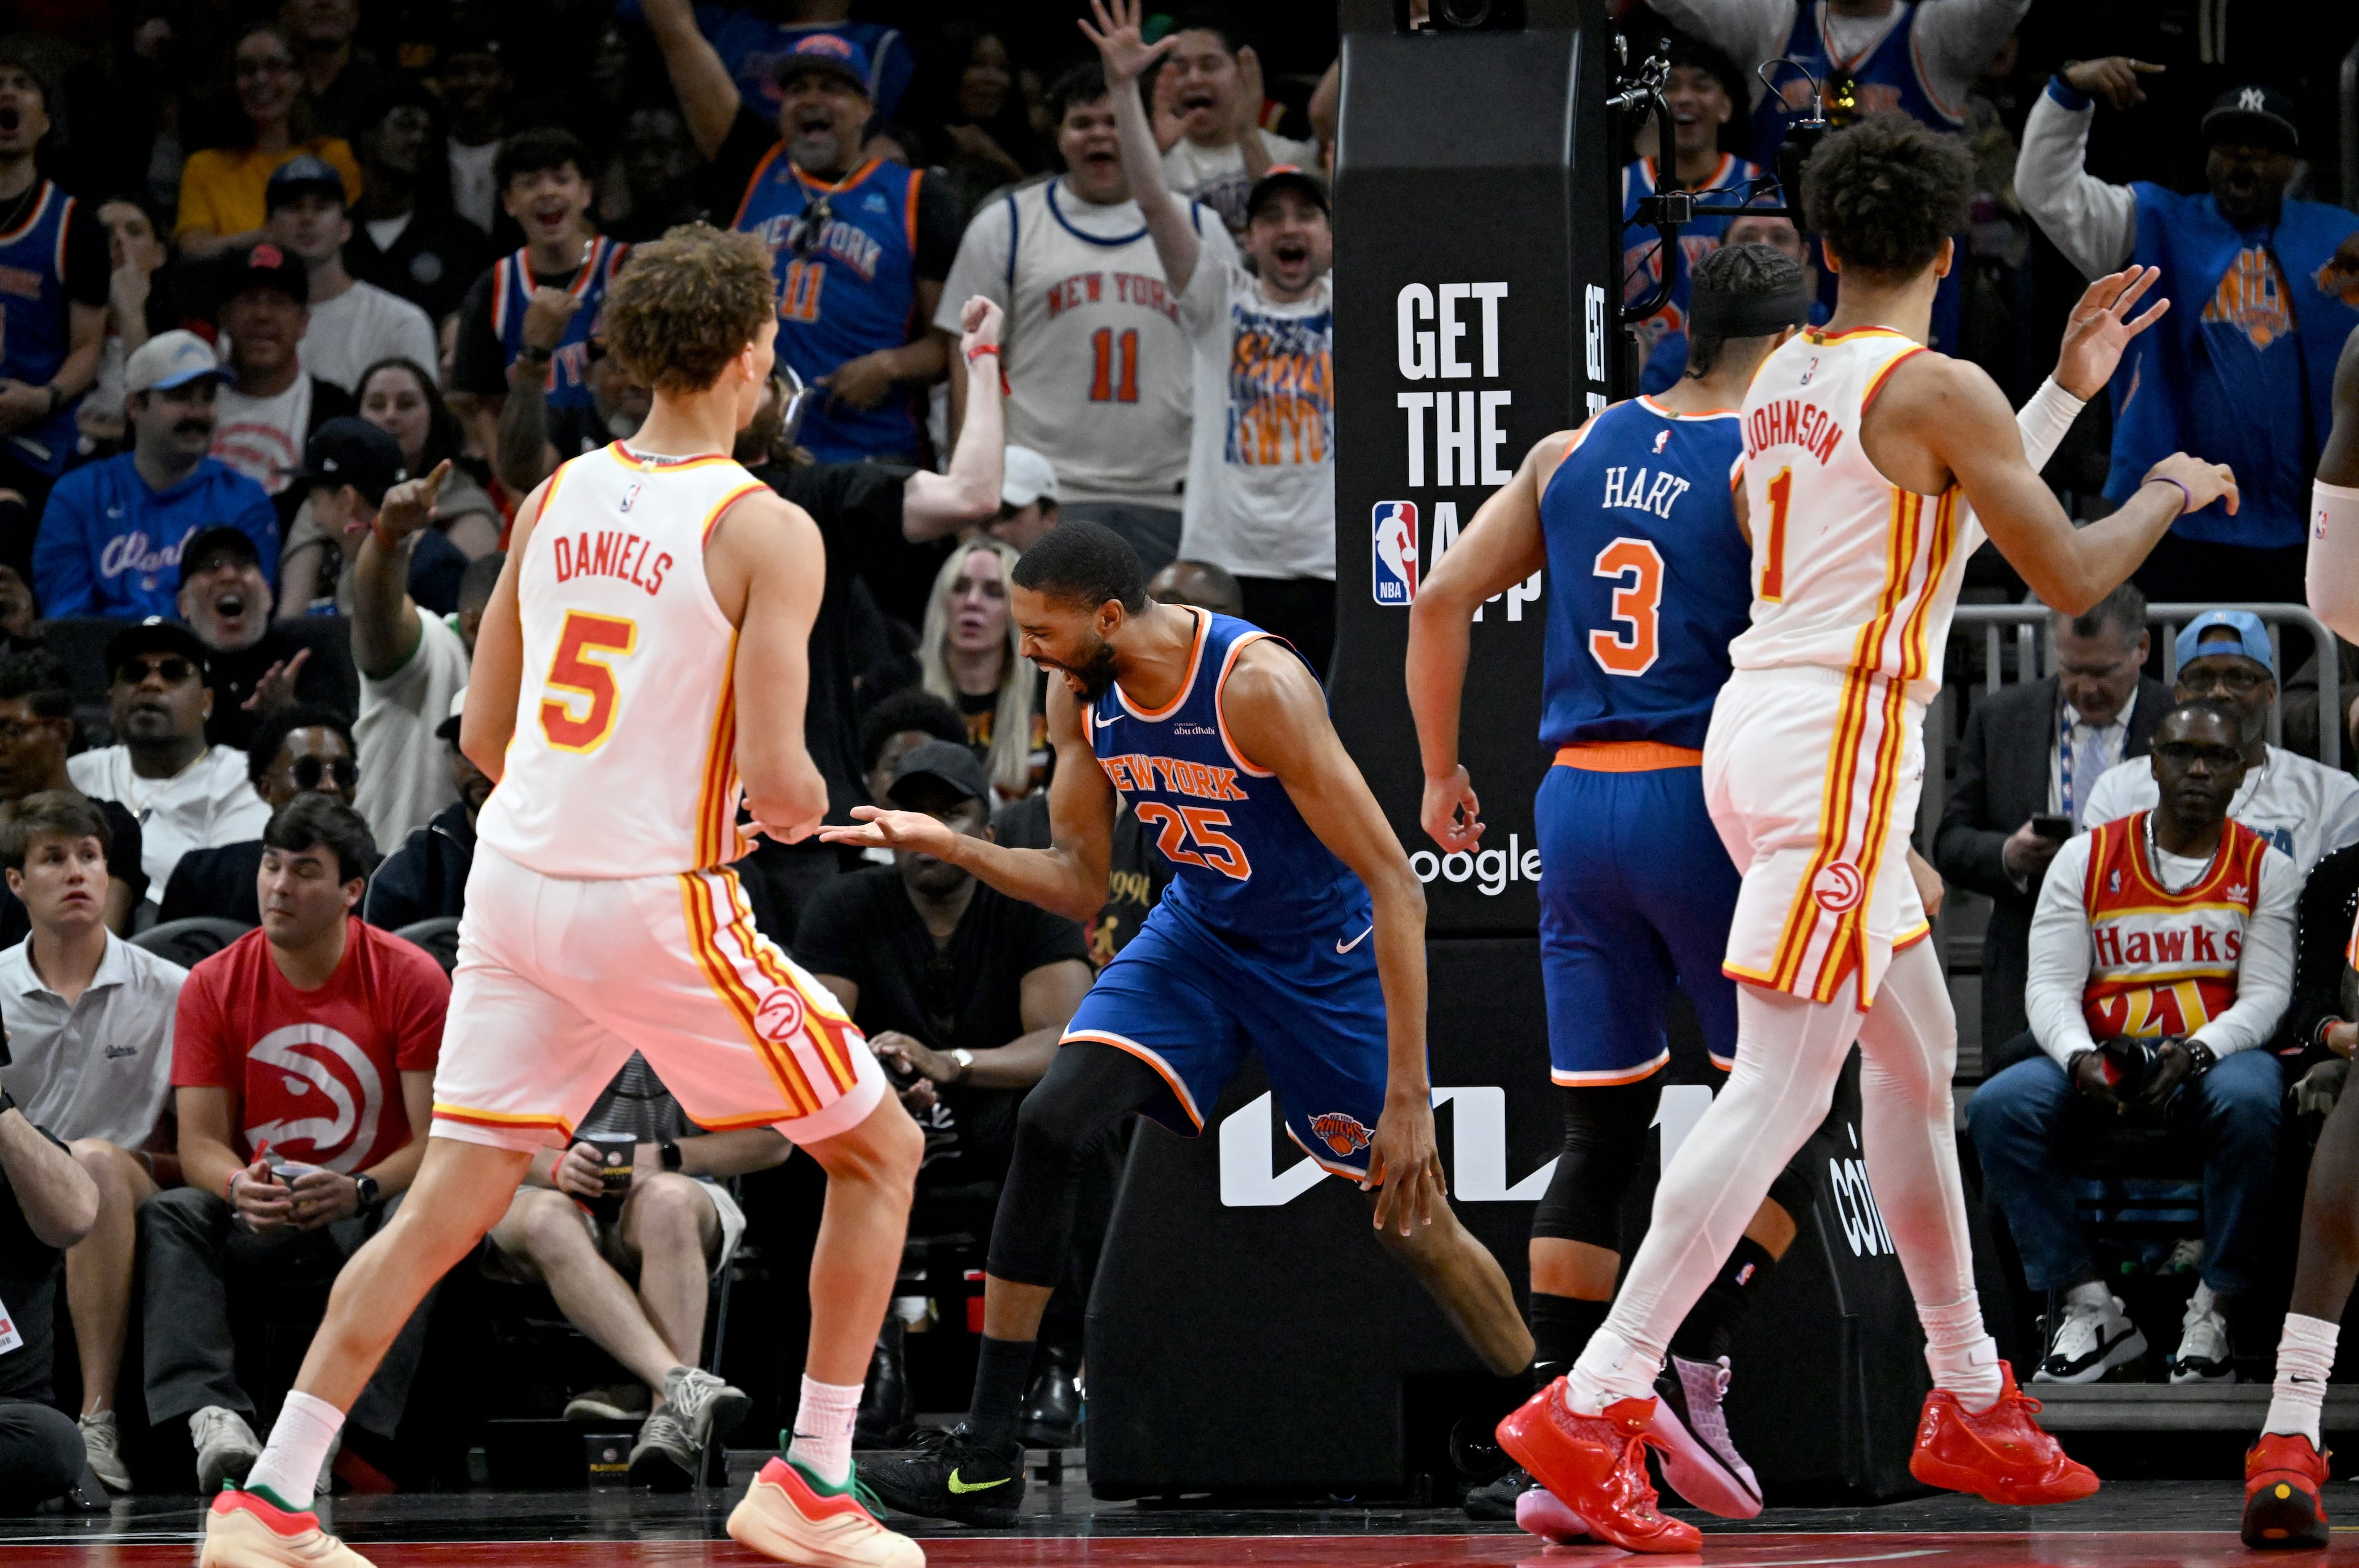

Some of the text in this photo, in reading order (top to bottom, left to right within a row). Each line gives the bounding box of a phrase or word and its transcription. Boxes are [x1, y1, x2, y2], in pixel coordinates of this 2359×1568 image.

[778, 260, 826, 324] 11
[1048, 272, 1103, 320] NEW
[1397, 282, 1508, 380] GET
[1586, 283, 1605, 382] GET
[1087, 326, 1140, 403] 11
[1397, 390, 1512, 487] THE
[1748, 399, 1844, 467] JOHNSON
[1602, 466, 1691, 520] HART
[554, 531, 673, 596] DANIELS
[1759, 465, 1793, 604] 1
[1380, 582, 1402, 599] NBA
[1589, 536, 1665, 677] 3
[537, 607, 638, 756] 5
[1174, 726, 1215, 735] abu dhabi
[1151, 756, 1250, 801] YORK
[1134, 801, 1253, 882] 25
[1409, 833, 1543, 896] oogle
[2094, 924, 2242, 968] Hawks
[1314, 1117, 1367, 1145] KNICKS
